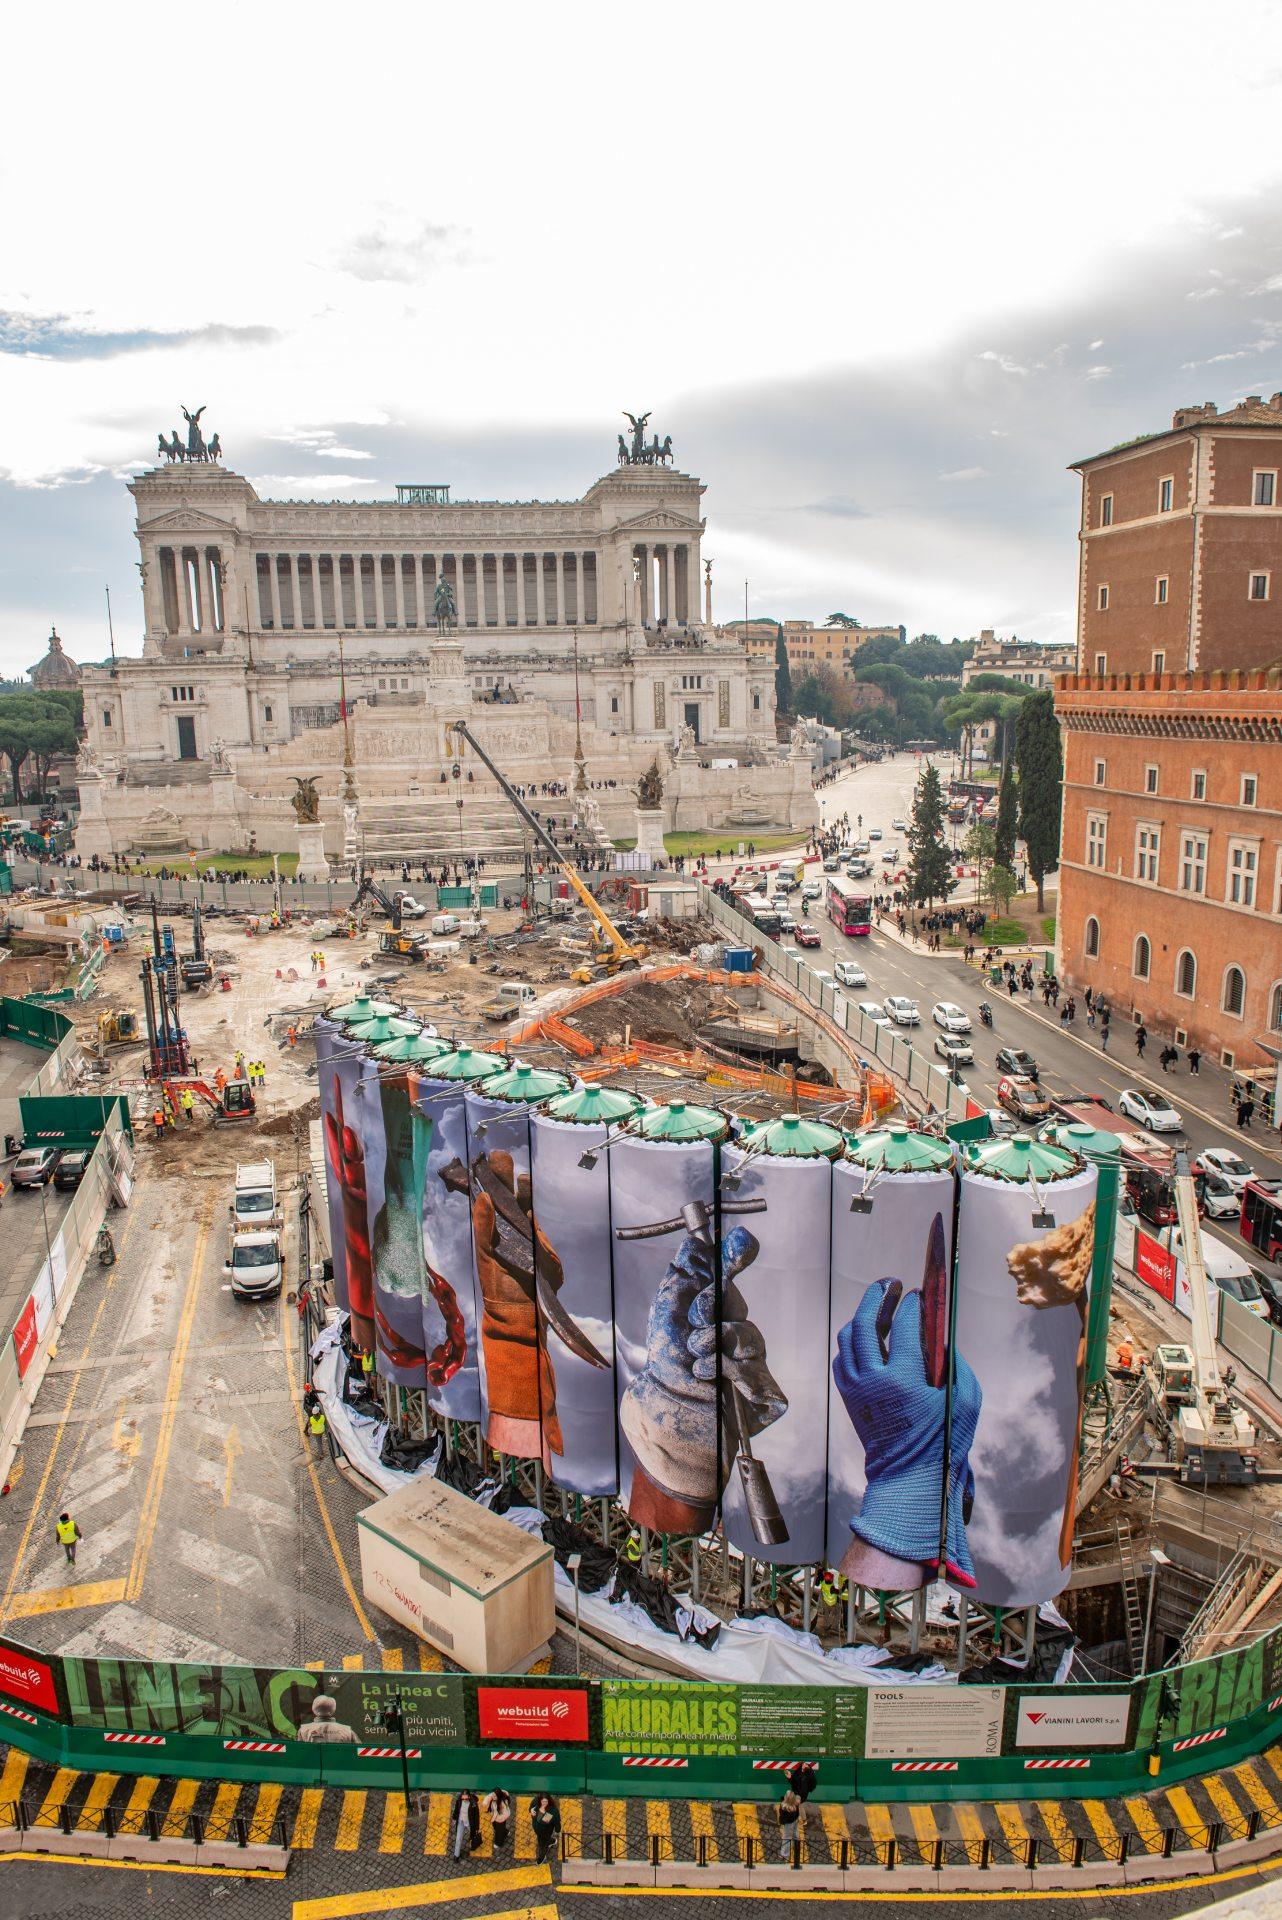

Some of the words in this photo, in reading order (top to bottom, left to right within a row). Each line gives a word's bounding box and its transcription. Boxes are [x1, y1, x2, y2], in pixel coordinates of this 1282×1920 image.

[0, 1662, 28, 1680] ebuild
[361, 1683, 381, 1695] La
[386, 1684, 432, 1697] Linea
[436, 1685, 448, 1697] C
[63, 1657, 272, 1740] LINEA
[362, 1697, 379, 1710] fa
[497, 1706, 549, 1717] webuild
[604, 1698, 737, 1736] MURALES
[405, 1716, 424, 1727] più
[426, 1717, 455, 1727] uniti,
[408, 1727, 426, 1737] più
[428, 1726, 457, 1737] vicini
[605, 1729, 624, 1738] Arte
[625, 1730, 697, 1741] contemporanea
[709, 1733, 737, 1741] metro
[985, 1719, 999, 1753] ROMA
